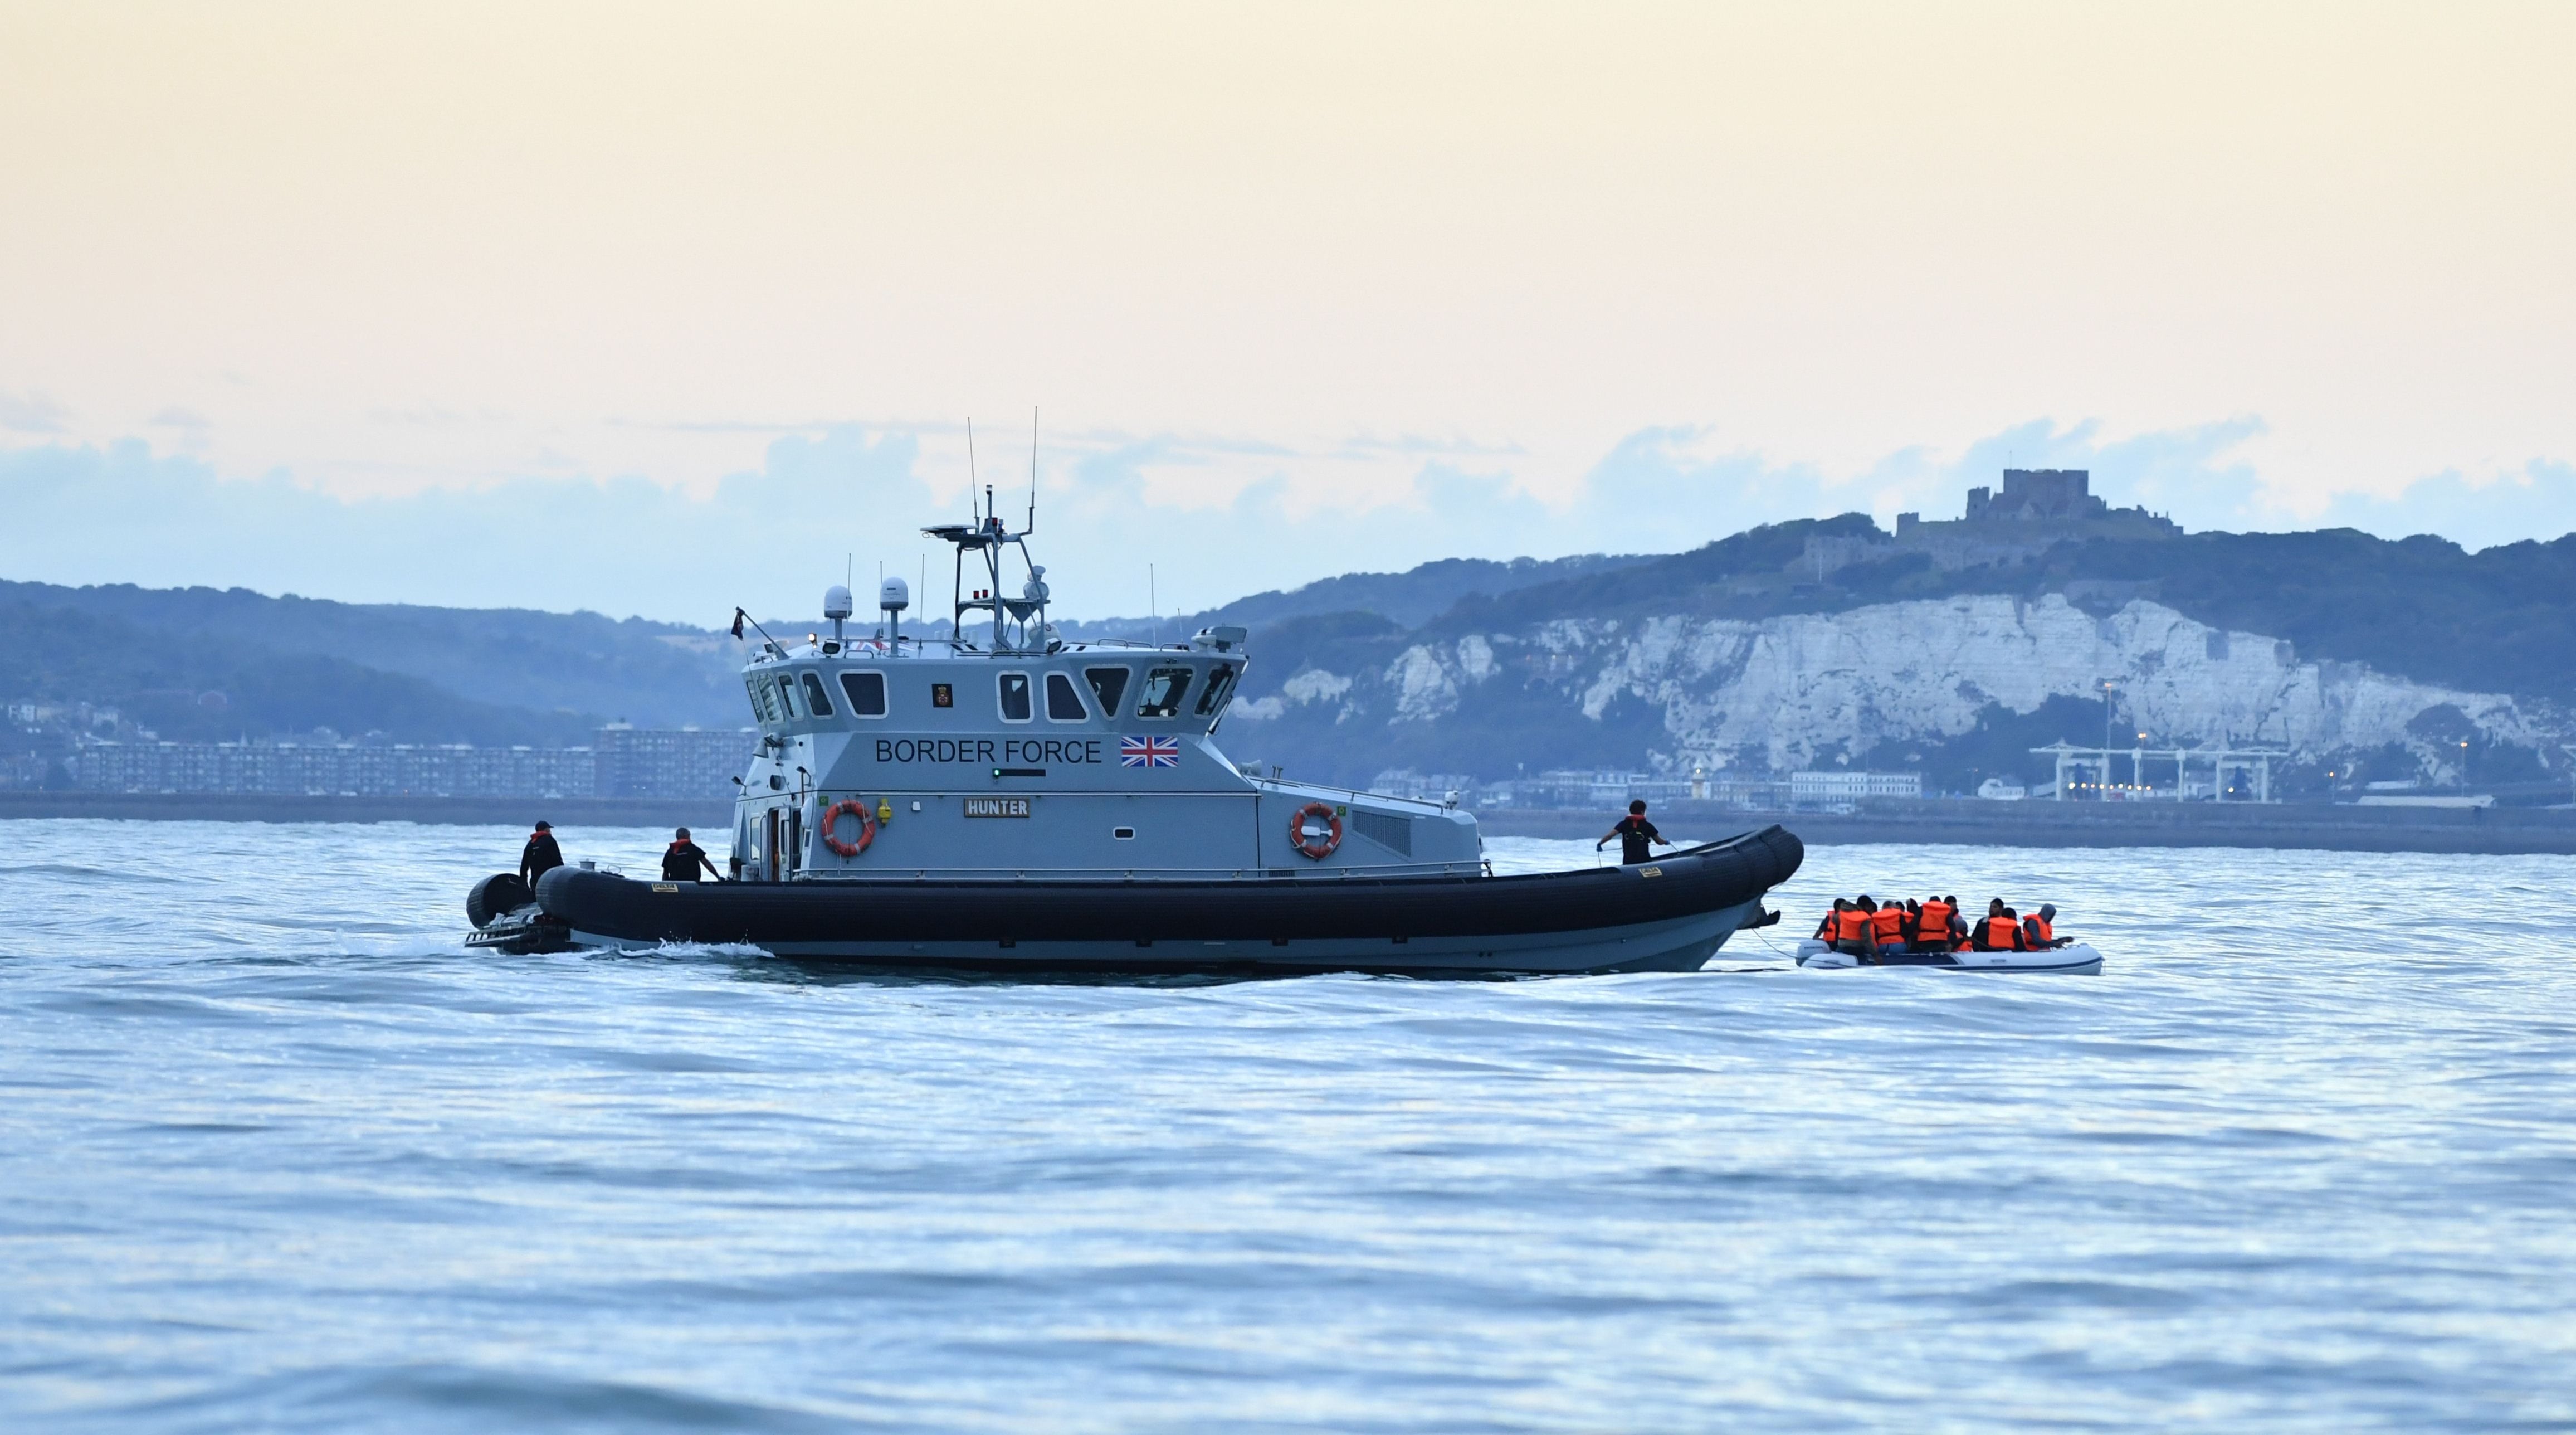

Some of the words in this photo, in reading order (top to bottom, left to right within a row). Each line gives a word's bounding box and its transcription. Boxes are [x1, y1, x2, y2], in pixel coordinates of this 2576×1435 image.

[876, 739, 996, 763] BORDER
[1006, 740, 1102, 763] FORCE
[968, 800, 1028, 815] HUNTER
